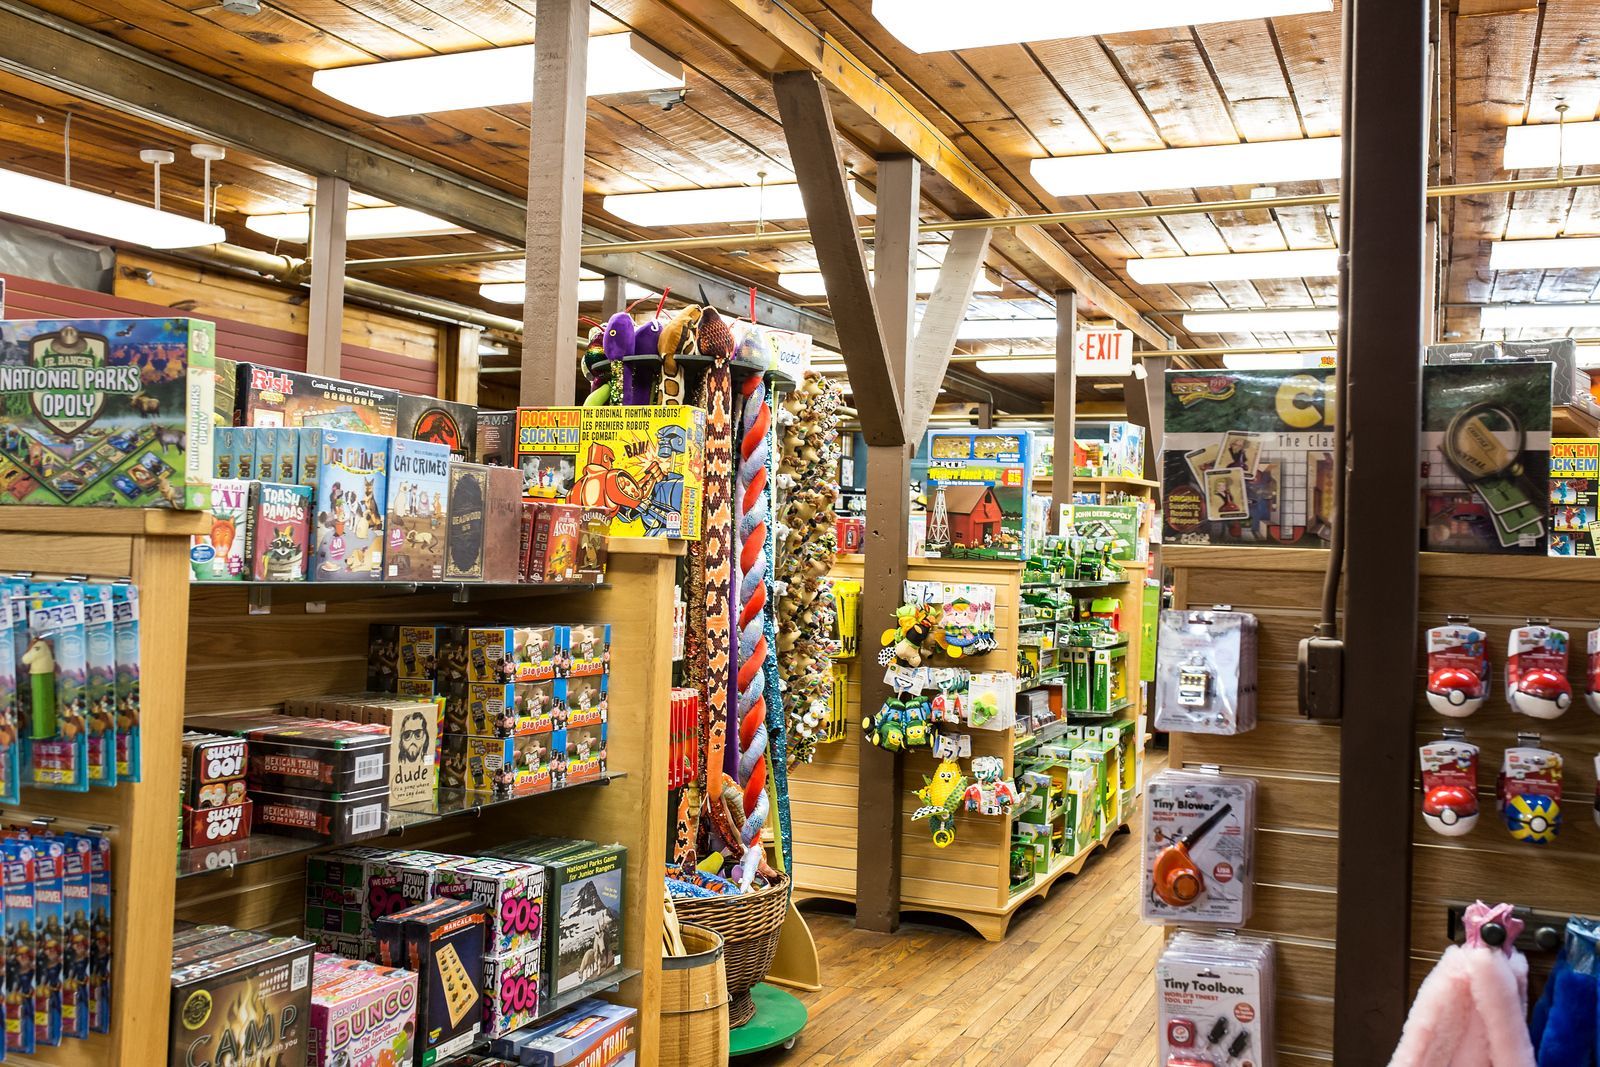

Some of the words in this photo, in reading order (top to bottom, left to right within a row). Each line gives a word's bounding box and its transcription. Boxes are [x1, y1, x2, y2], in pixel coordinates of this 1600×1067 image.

[1086, 334, 1122, 360] EXIT
[58, 355, 93, 366] RANGER
[0, 367, 79, 390] NATIONAL
[84, 366, 140, 391] PARKS
[251, 369, 293, 395] Risk
[311, 379, 329, 390] Control
[353, 387, 369, 397] Control
[42, 393, 95, 417] OPOLY
[583, 409, 593, 418] THE
[595, 408, 622, 418] ORIGINAL
[624, 408, 651, 418] FIGHTING
[654, 408, 681, 418] ROBOTS!
[199, 412, 209, 445] OPOLY
[582, 421, 593, 430] LES
[595, 421, 624, 430] PREMIERS
[626, 421, 650, 431] ROBOTS
[582, 432, 590, 441] DE
[592, 432, 618, 441] COMBAT!
[1279, 434, 1301, 447] The
[1308, 434, 1336, 447] Clas
[323, 444, 343, 465] DOG
[623, 440, 649, 458] BAM!
[394, 455, 411, 472] CAT
[413, 456, 447, 476] CRIMES
[263, 487, 301, 506] TRASH
[263, 502, 304, 521] PANDAS
[452, 510, 482, 526] DEADWOOD
[1075, 511, 1091, 519] JOHN
[1092, 511, 1132, 520] DEERE-OPOLY
[391, 528, 401, 539] 40
[553, 521, 577, 538] ASSETS
[245, 530, 253, 559] PANDAS
[332, 538, 342, 548] 40
[207, 744, 244, 760] SUSHI
[208, 757, 242, 778] GO!
[264, 755, 296, 767] MEXICAN
[298, 759, 319, 771] TRAIN
[264, 765, 319, 776] DOMINOES
[395, 765, 428, 784] dude
[1153, 799, 1174, 811] Tiny
[1177, 800, 1215, 811] Blower
[206, 805, 242, 823] SUSHI
[263, 806, 294, 818] MEXICAN
[295, 810, 317, 822] TRAIN
[263, 815, 316, 827] DOMINOES
[206, 817, 240, 840] GO!
[566, 861, 588, 874] National
[589, 858, 603, 868] Parks
[603, 855, 618, 863] Game
[578, 869, 594, 879] Junior
[595, 863, 615, 874] Rangers
[371, 878, 382, 886] WE
[382, 877, 397, 886] LOVE
[403, 873, 425, 886] TRIVIA
[473, 880, 495, 893] TRIVIA
[528, 871, 543, 886] TRIVIA
[402, 885, 424, 899] BOX
[440, 885, 450, 893] WE
[451, 884, 465, 892] LOVE
[503, 890, 512, 900] WE
[512, 882, 524, 896] LOVE
[527, 884, 541, 900] BOX
[6, 894, 33, 908] MARVEL
[472, 892, 495, 908] BOX
[442, 916, 473, 932] MANCALA
[502, 899, 540, 933] 90s
[340, 941, 358, 954] TRIVIA
[503, 968, 511, 979] WE
[511, 962, 521, 974] LOVE
[524, 960, 538, 977] BOX
[1164, 978, 1189, 991] Tiny
[1192, 980, 1244, 995] Toolbox
[501, 977, 536, 1013] 90s
[350, 999, 360, 1012] of
[334, 984, 414, 1048] BUNCO
[186, 1004, 297, 1067] CAMP
[284, 1038, 298, 1050] you
[603, 1026, 628, 1064] TRAIL
